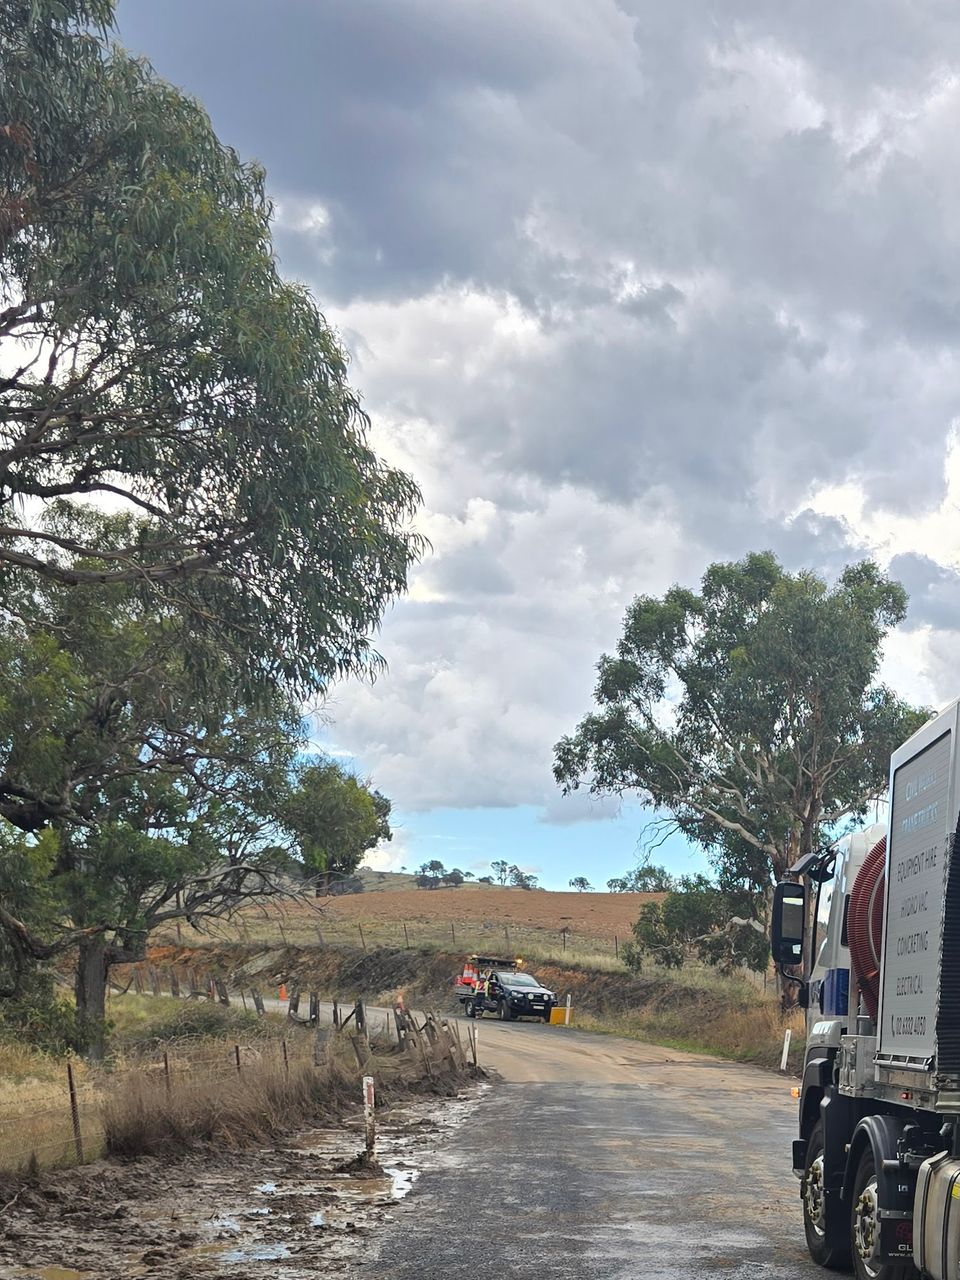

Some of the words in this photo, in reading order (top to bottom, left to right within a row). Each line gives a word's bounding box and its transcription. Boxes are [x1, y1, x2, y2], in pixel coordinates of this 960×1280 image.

[897, 852, 925, 883] EQUIPMENT
[925, 846, 938, 869] HIRE
[896, 931, 929, 957] CONCRETING
[896, 975, 924, 997] ELECTRICAL
[896, 1016, 902, 1036] 02
